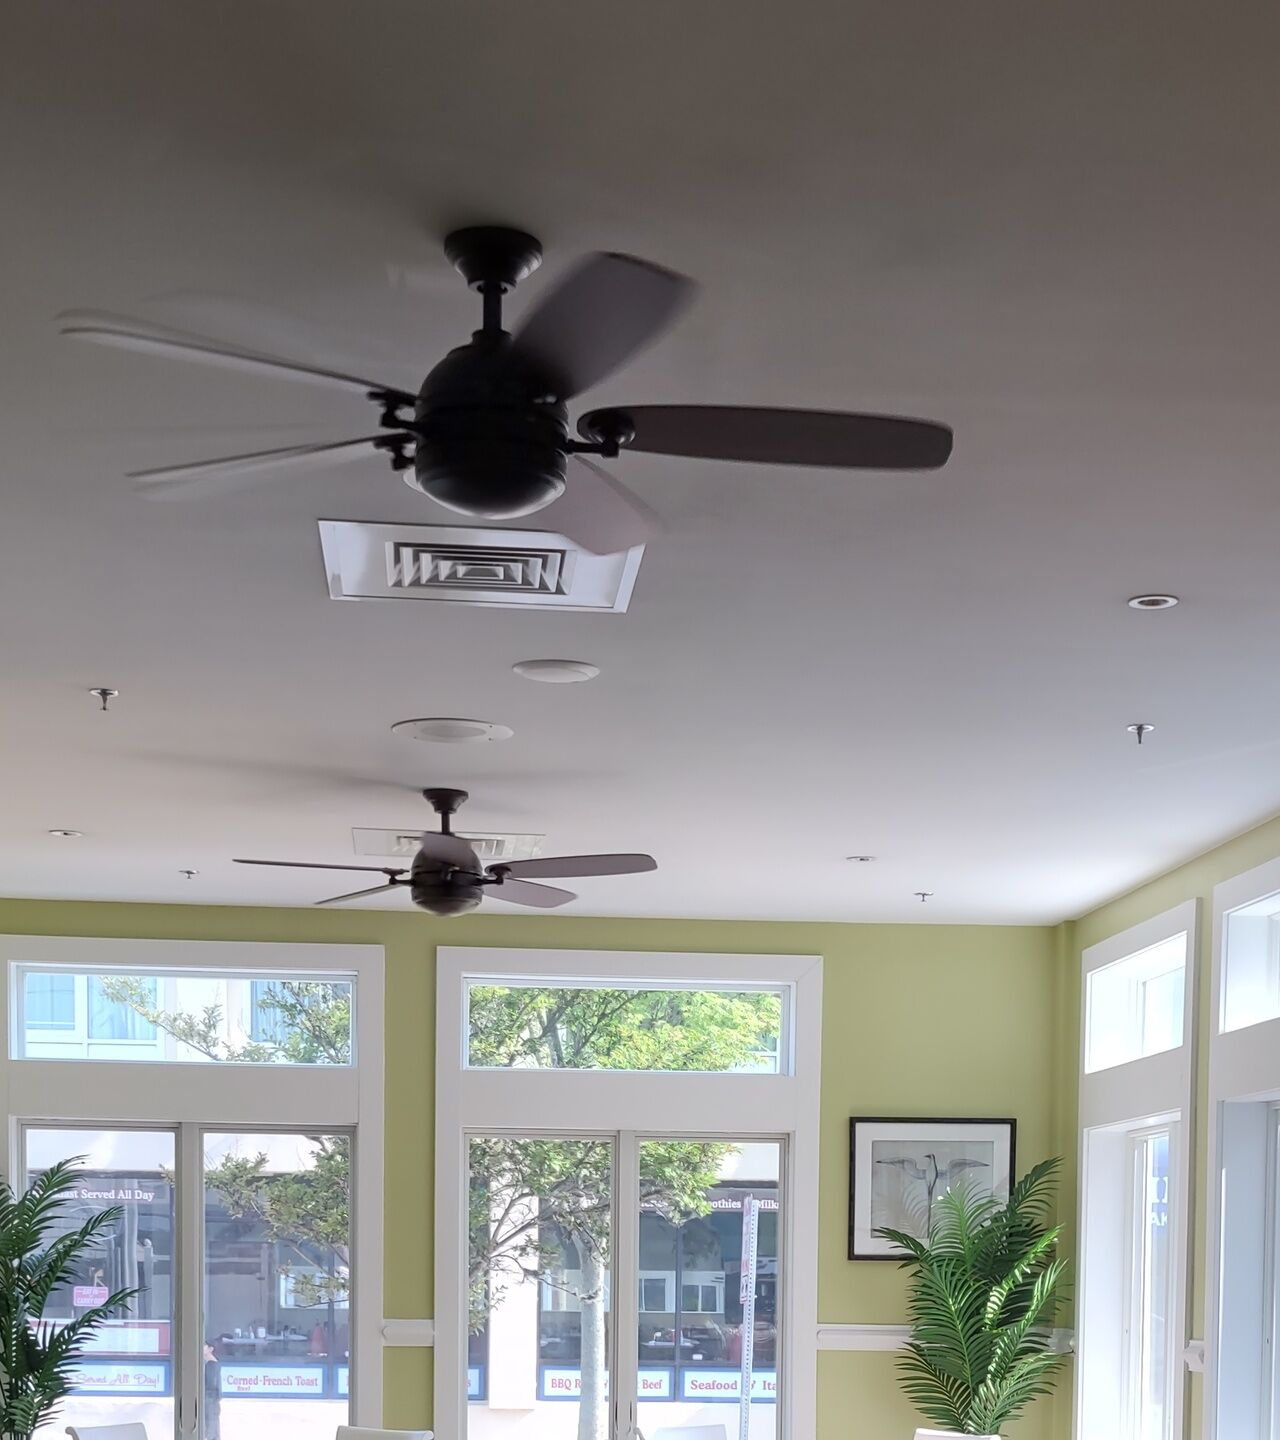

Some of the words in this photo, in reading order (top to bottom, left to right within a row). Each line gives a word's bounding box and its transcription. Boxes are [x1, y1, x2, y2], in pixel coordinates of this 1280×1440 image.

[81, 1188, 115, 1199] Served
[117, 1188, 132, 1199] All
[134, 1189, 155, 1202] Day
[262, 1375, 293, 1386] French
[295, 1375, 318, 1387] Toast
[551, 1378, 572, 1391] BBQ
[642, 1378, 663, 1390] Beef
[690, 1379, 738, 1391] Seafood
